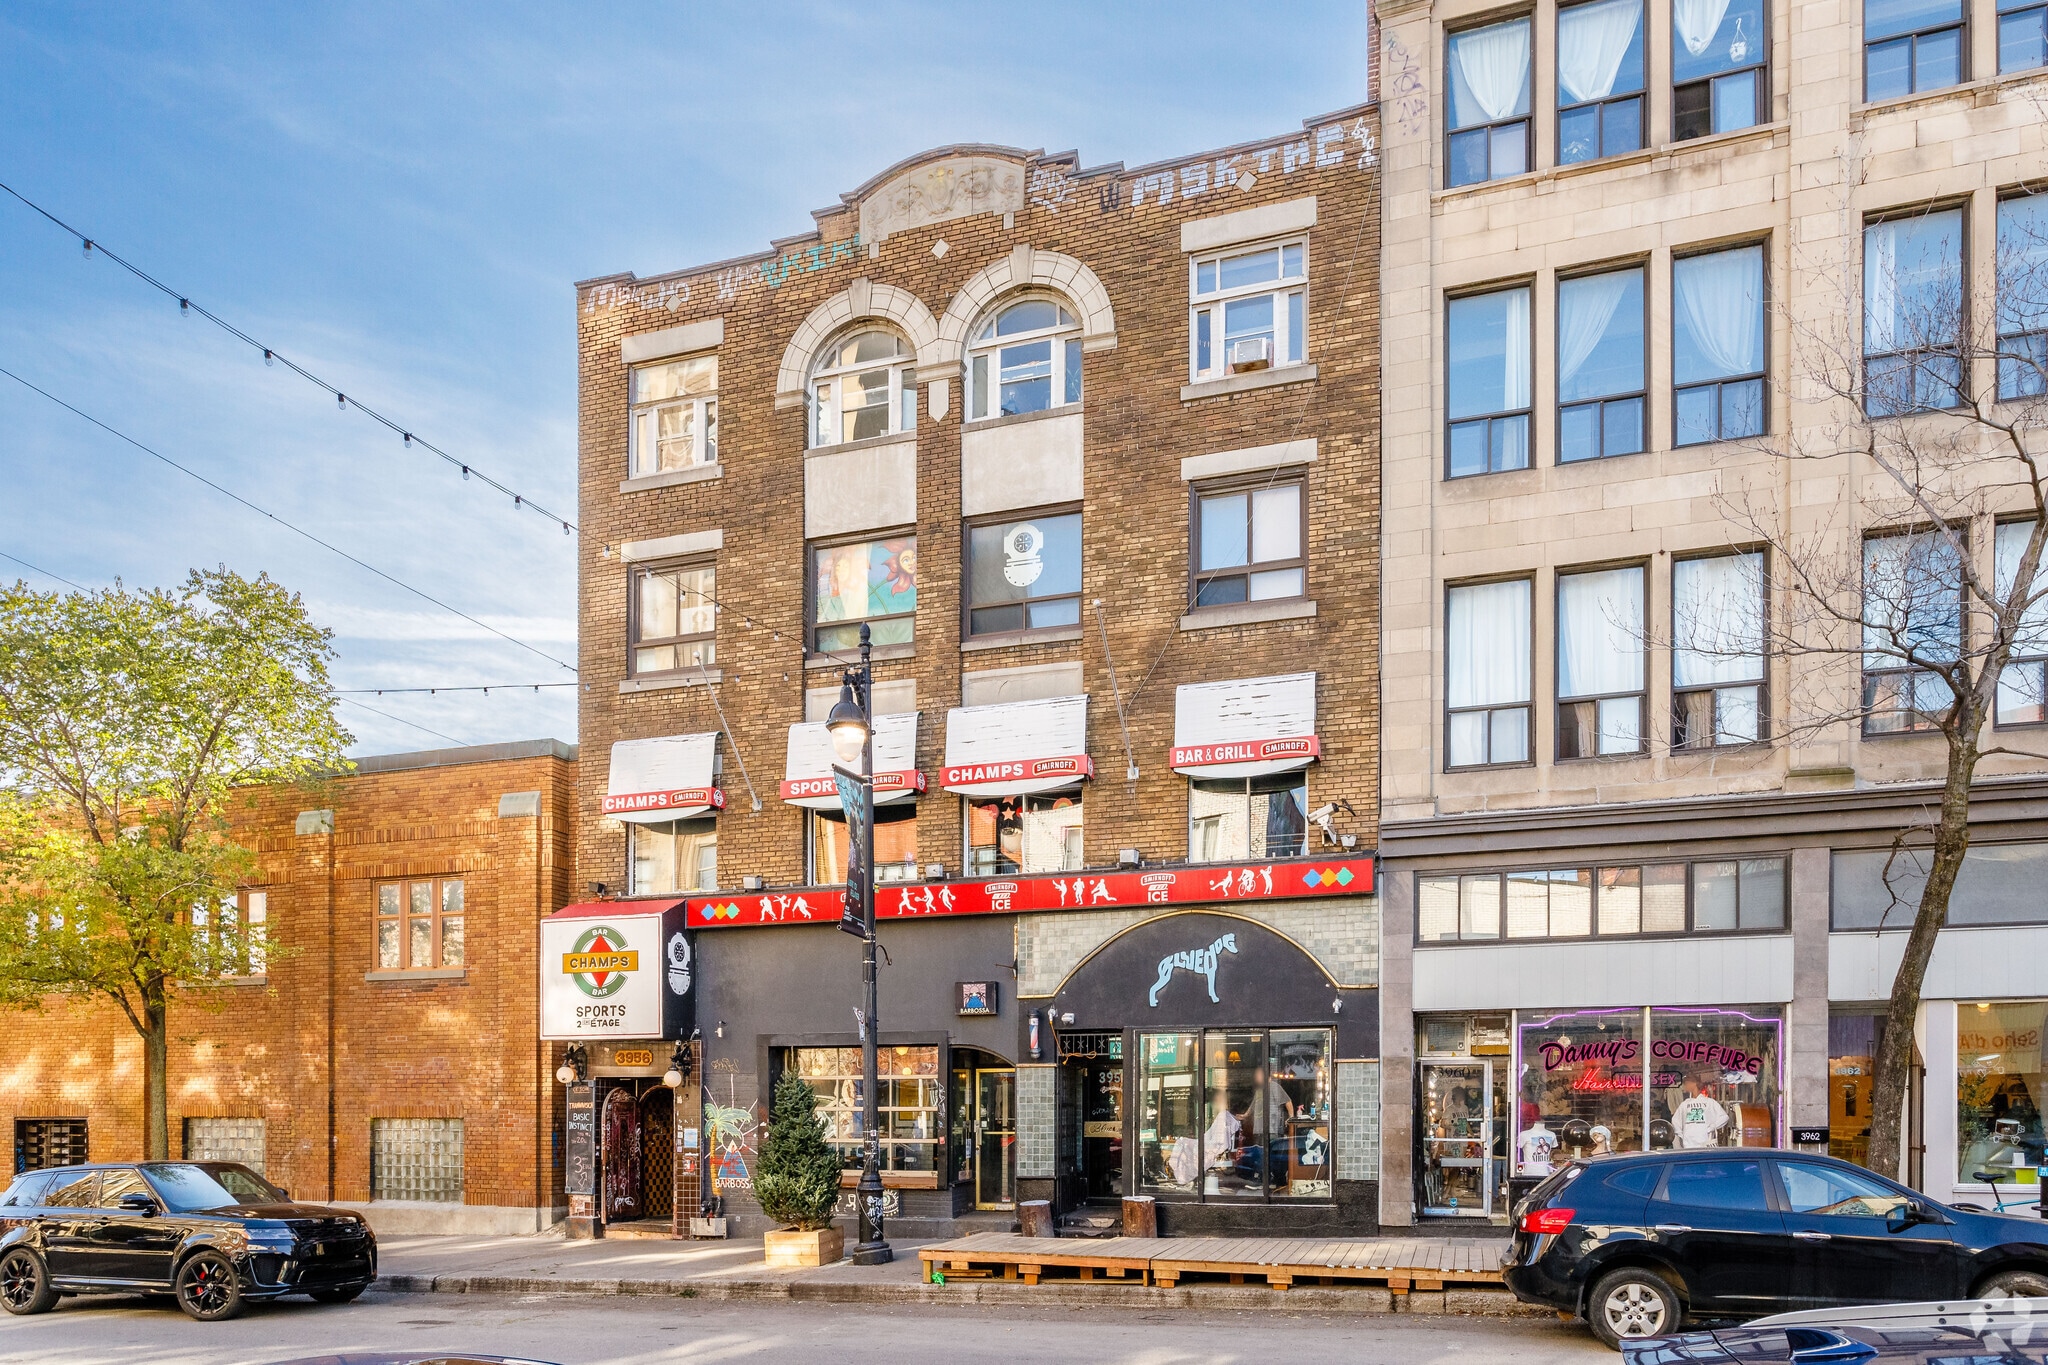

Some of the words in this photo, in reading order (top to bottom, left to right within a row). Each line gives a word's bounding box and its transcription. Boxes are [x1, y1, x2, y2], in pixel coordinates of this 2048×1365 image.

[1176, 749, 1203, 763] BAR
[1206, 748, 1212, 761] &
[1214, 744, 1255, 760] GRILL
[948, 764, 1024, 782] CHAMPS
[605, 794, 667, 810] CHAMPS
[1148, 891, 1169, 902] ICE
[991, 900, 1011, 910] ICE
[570, 956, 630, 969] CHAMPS
[592, 988, 608, 996] BAR
[576, 1004, 626, 1018] SPORTS
[590, 1018, 620, 1027] ÉTAGE
[616, 1052, 651, 1064] 3956
[1651, 1040, 1764, 1075] COIFFURE
[1440, 1067, 1470, 1078] 3960
[573, 1112, 590, 1121] BASIC
[568, 1121, 593, 1131] INSTINCT
[1801, 1132, 1820, 1141] 3962
